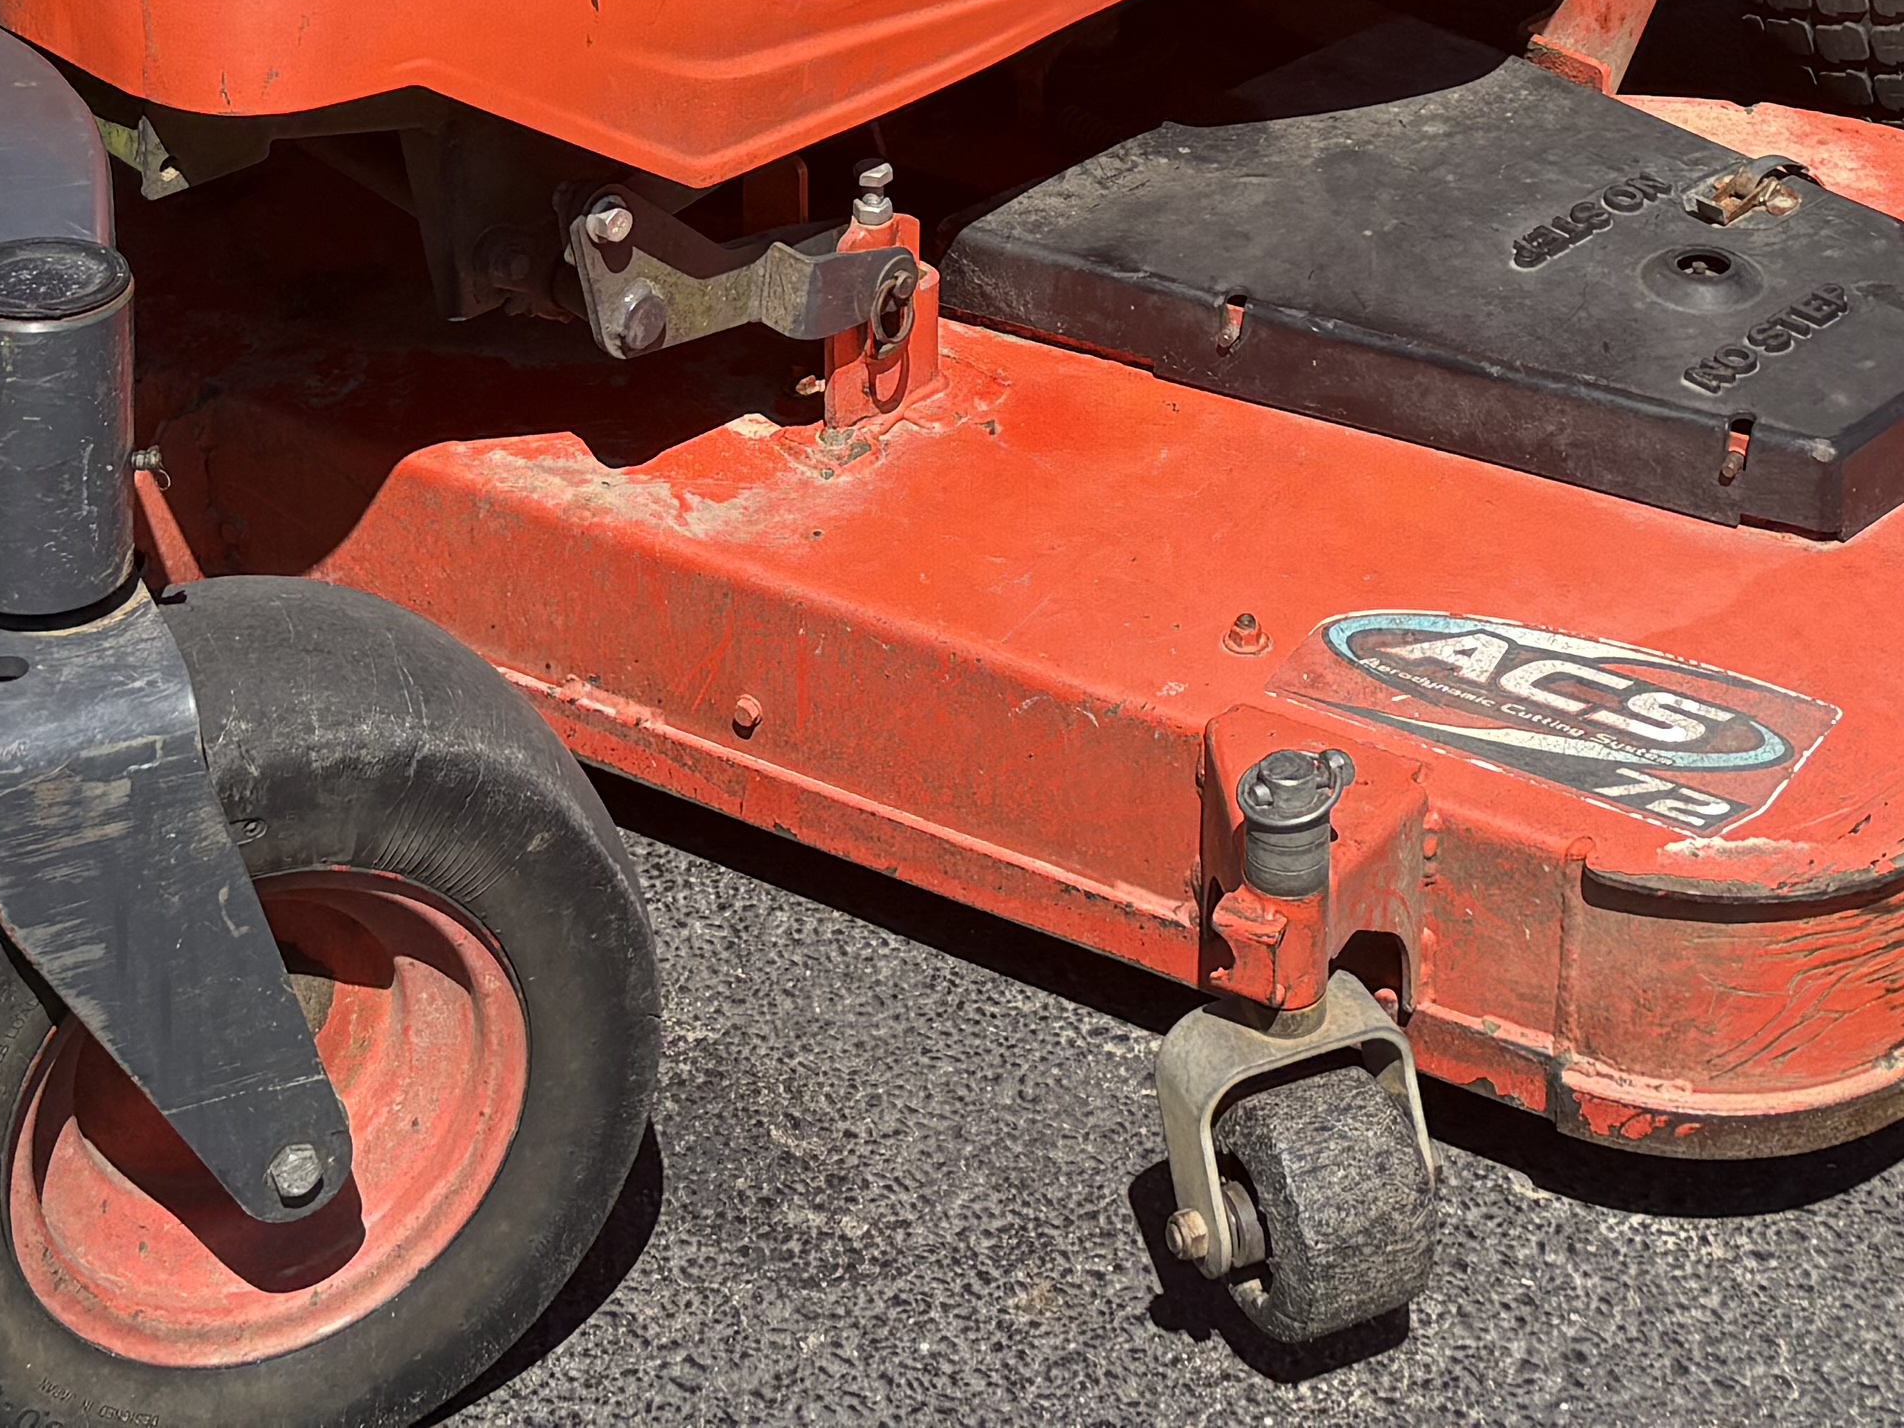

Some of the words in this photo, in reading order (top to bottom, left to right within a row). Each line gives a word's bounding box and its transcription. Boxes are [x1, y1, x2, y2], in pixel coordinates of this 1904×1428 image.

[1682, 344, 1760, 395] NO
[1745, 283, 1849, 355] STEP
[1358, 655, 1497, 710] Aerodynamic
[1501, 702, 1585, 738] Cutting
[1587, 730, 1674, 768] System
[1377, 632, 1736, 744] ACS
[1594, 767, 1734, 828] 72
